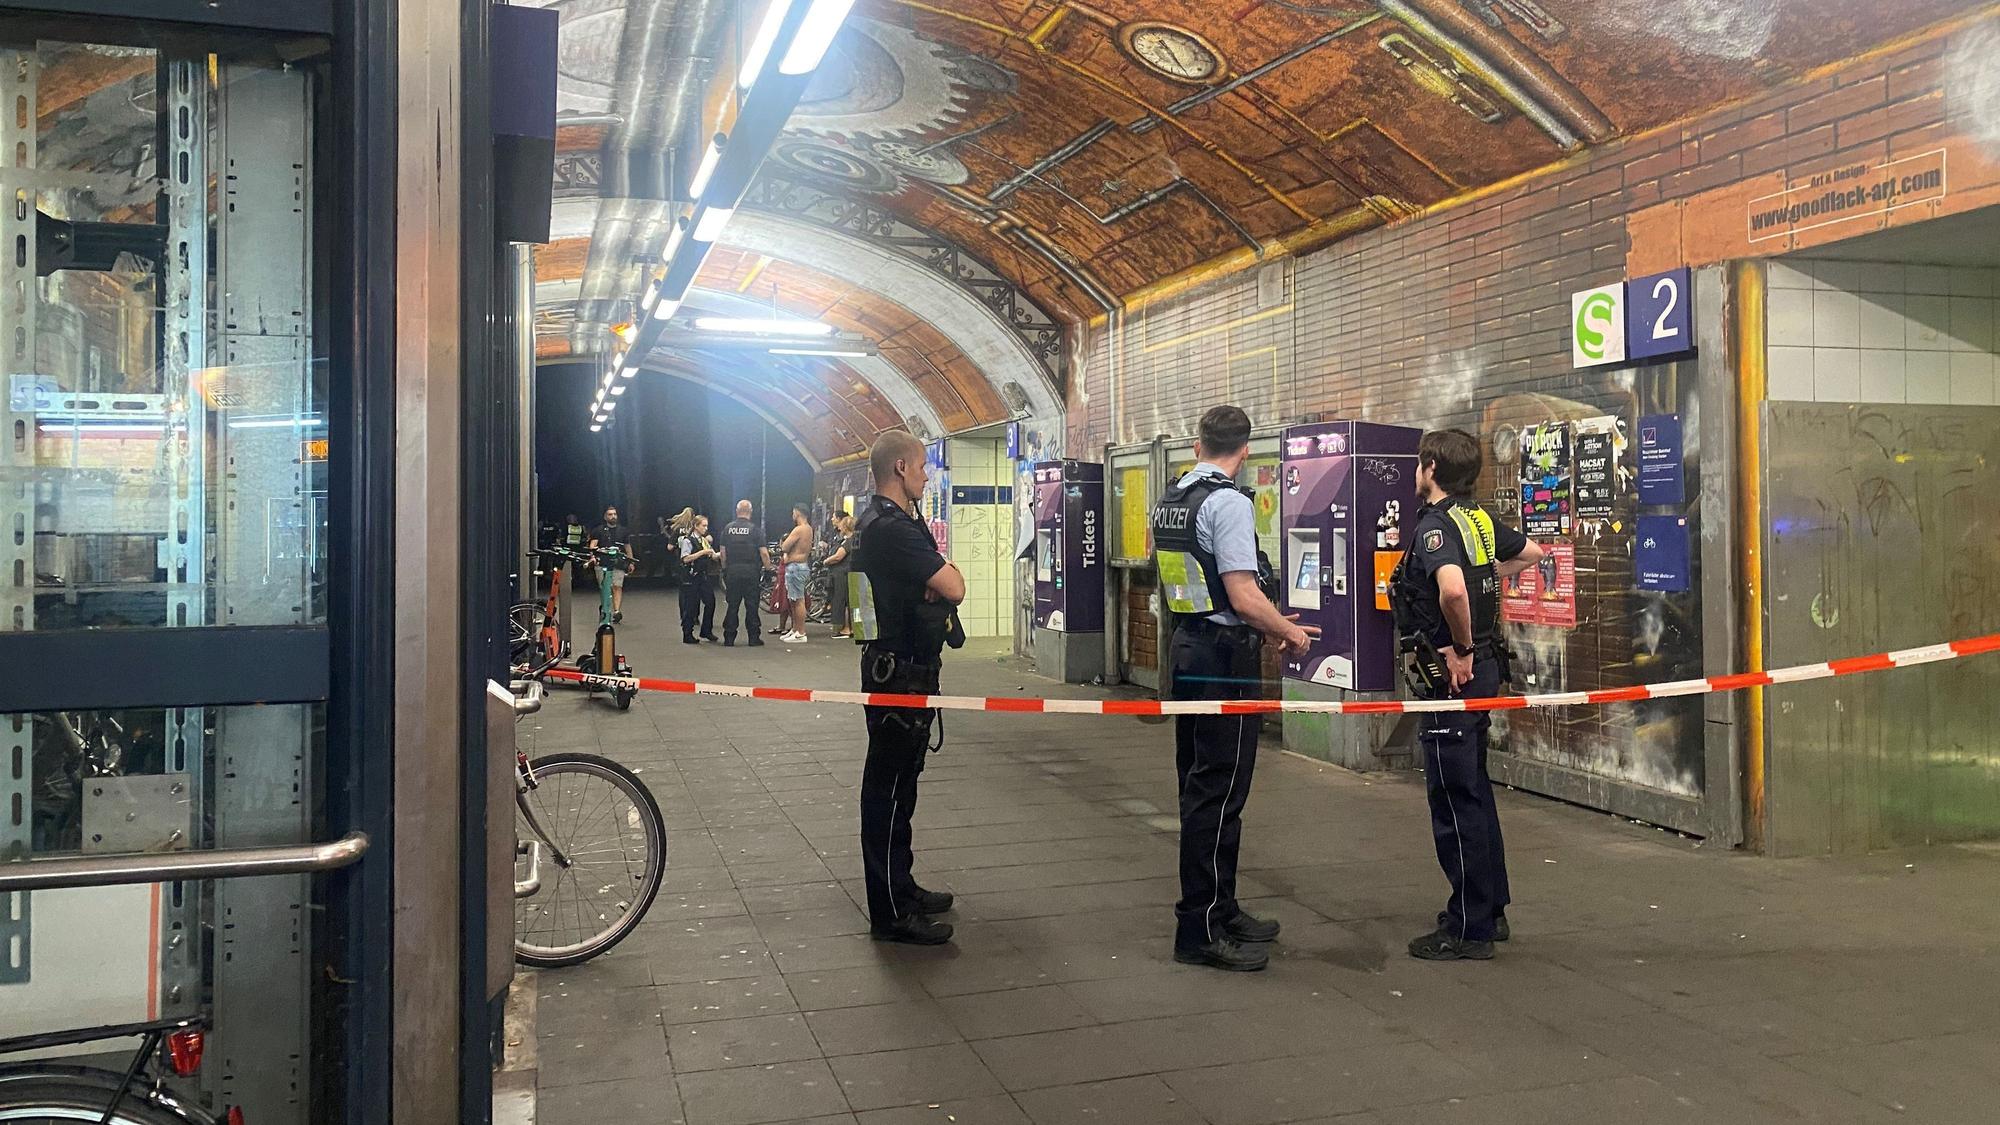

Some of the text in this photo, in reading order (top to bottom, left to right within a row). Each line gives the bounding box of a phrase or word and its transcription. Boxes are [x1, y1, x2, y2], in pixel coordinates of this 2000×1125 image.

[1810, 175, 1824, 189] Art
[1752, 167, 1941, 231] www.goodlack-art.com
[1652, 277, 1679, 340] 2
[1008, 428, 1013, 448] 3
[1579, 457, 1606, 468] MACSAT
[1153, 507, 1190, 529] POLIZEI
[728, 527, 749, 535] POLIZEI
[1082, 510, 1095, 568] Tickets
